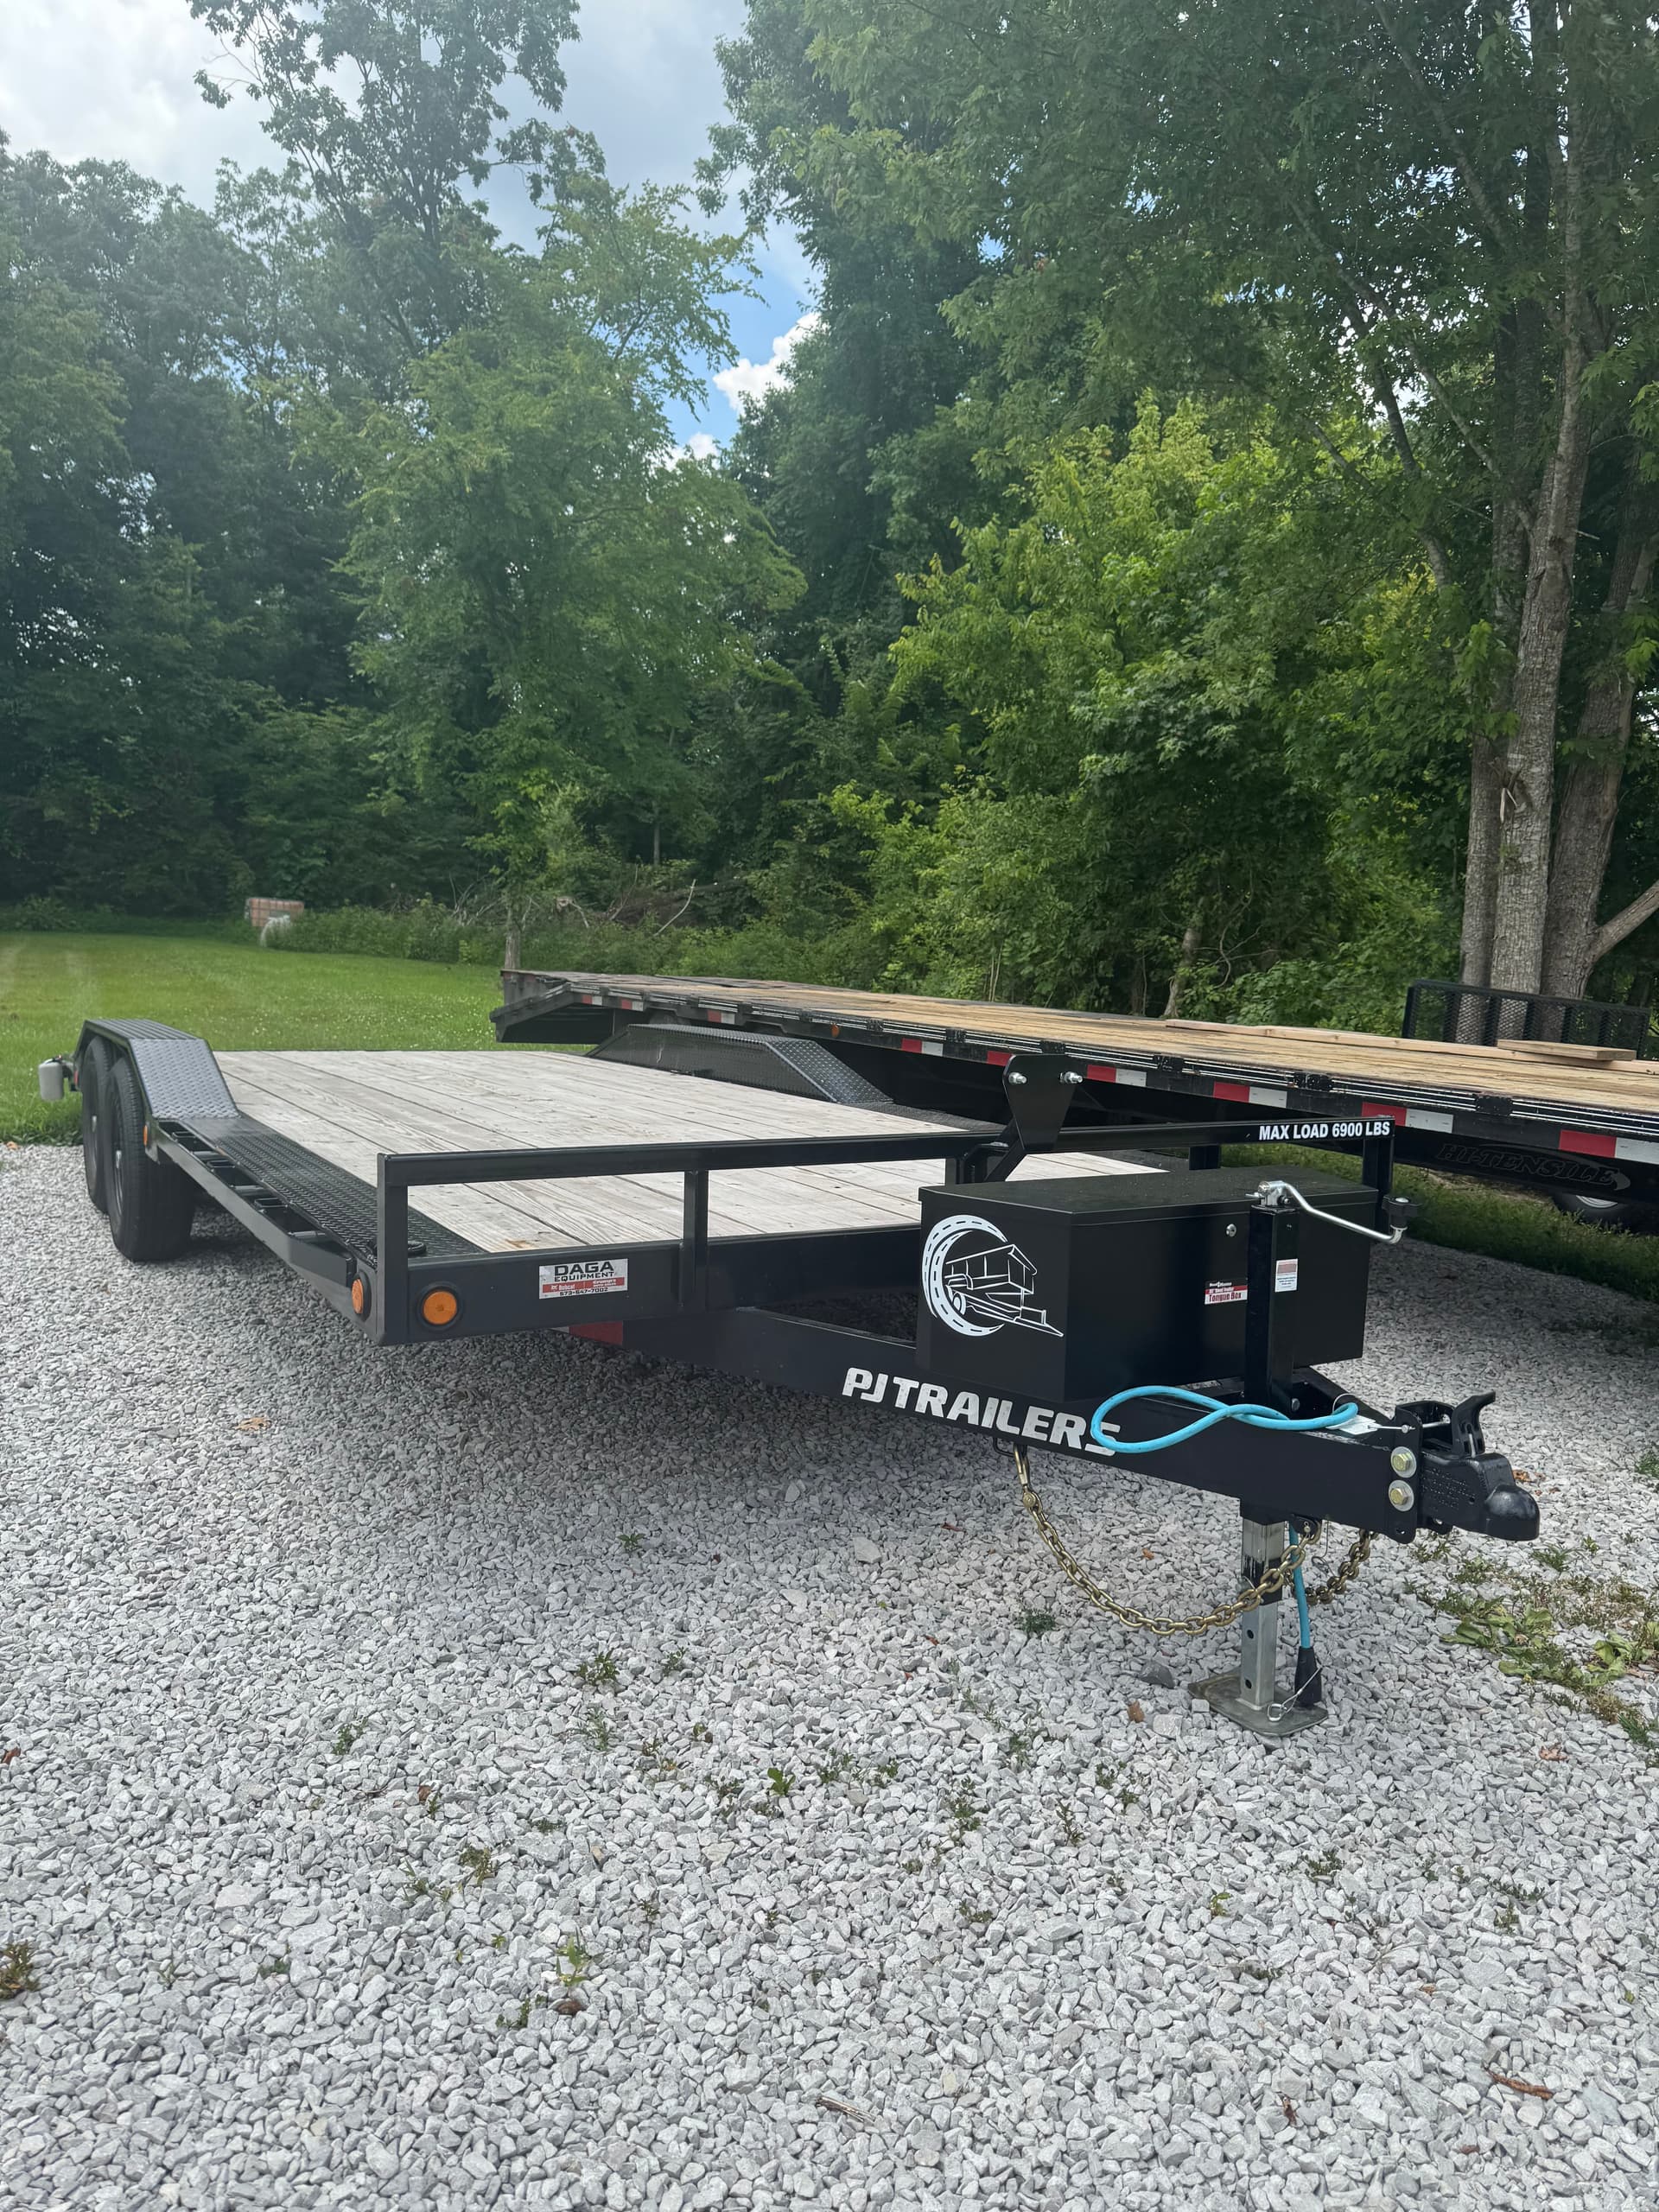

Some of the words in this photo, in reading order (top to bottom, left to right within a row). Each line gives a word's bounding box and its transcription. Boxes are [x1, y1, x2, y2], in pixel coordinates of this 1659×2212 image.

[1258, 1125, 1290, 1141] MAX
[1293, 1123, 1329, 1139] LOAD
[1332, 1122, 1363, 1137] 6900
[1365, 1122, 1390, 1136] LBS
[554, 1261, 614, 1276] DAGA
[554, 1271, 614, 1282] EQUIPMENT
[893, 1376, 1121, 1457] TRAILERS
